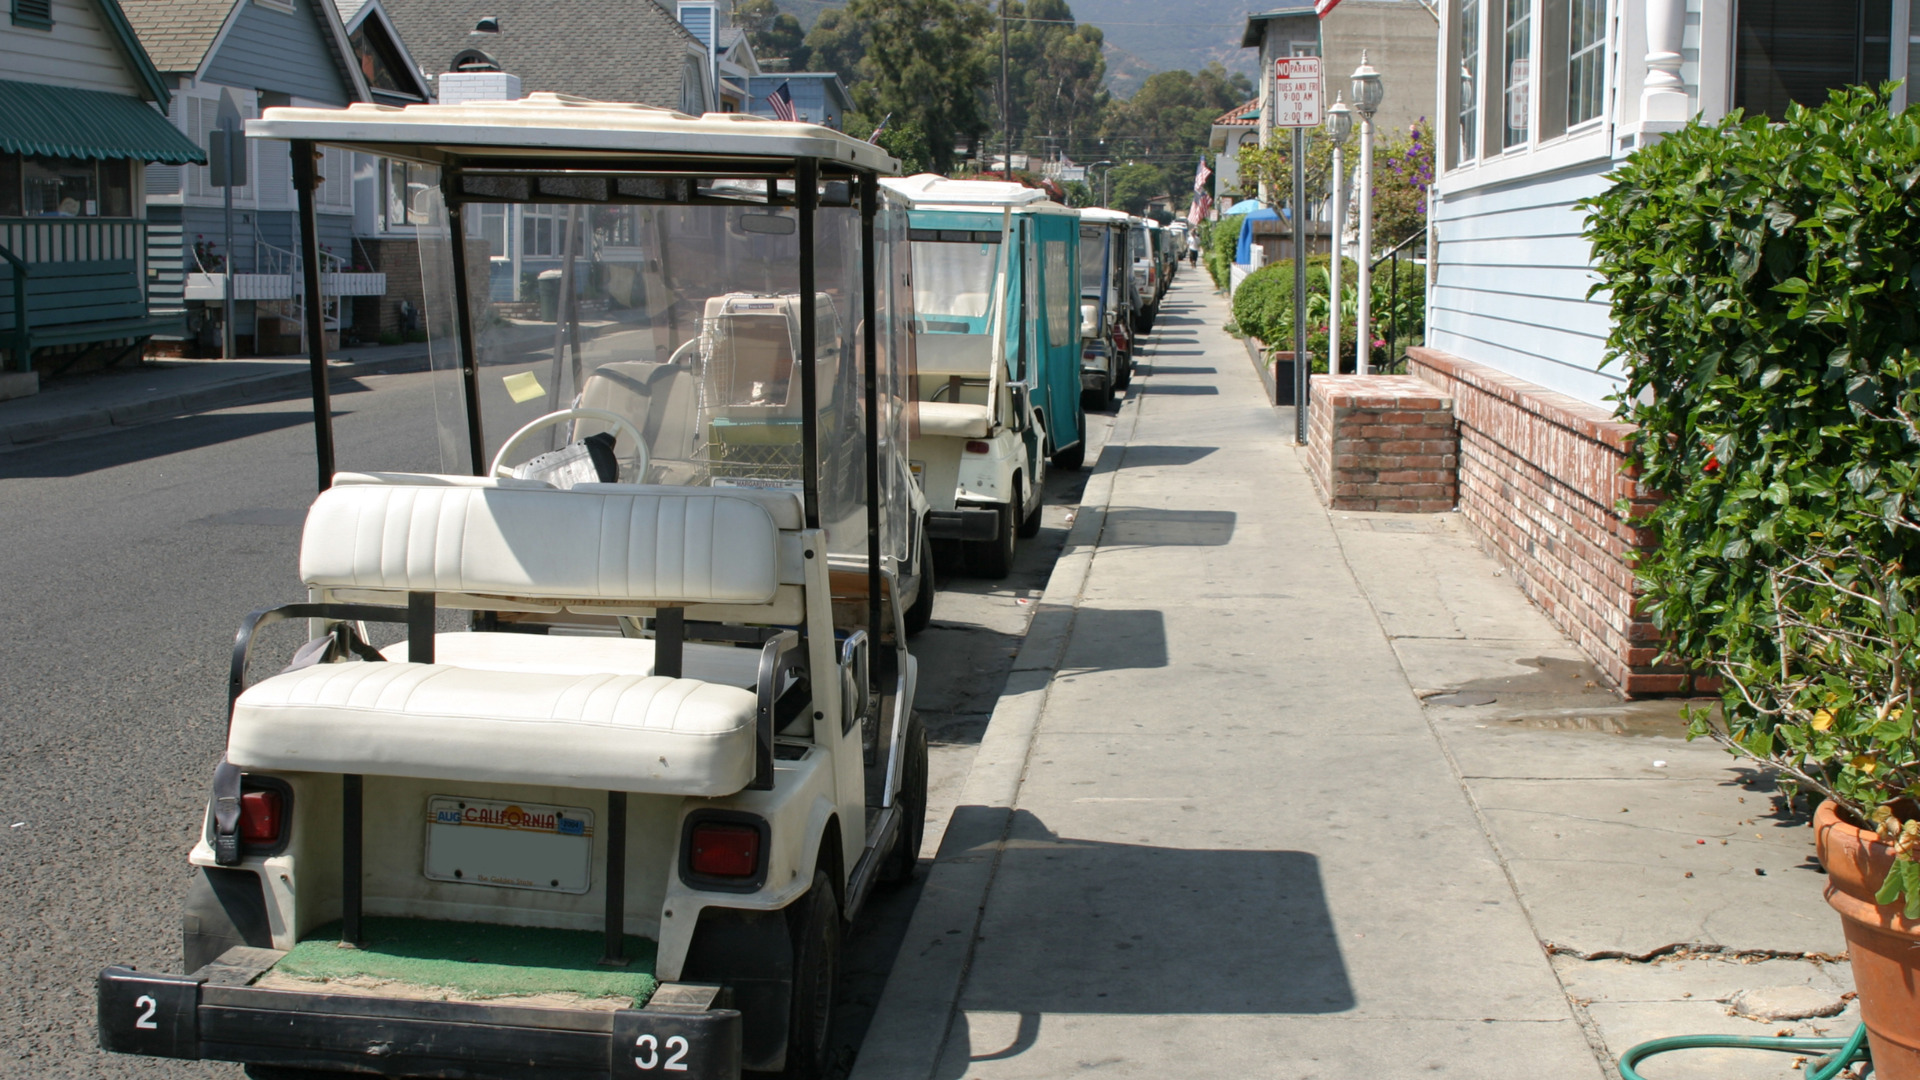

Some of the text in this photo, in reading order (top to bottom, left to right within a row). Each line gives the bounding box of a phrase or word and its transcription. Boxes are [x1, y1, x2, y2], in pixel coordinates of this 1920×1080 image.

[1277, 63, 1318, 76] NO PARKING
[1278, 82, 1319, 91] TUES AND FRI
[1283, 92, 1300, 101] 9:00
[1294, 102, 1302, 111] TO
[1283, 112, 1313, 121] 2:00 PM
[438, 811, 461, 822] AUG
[465, 808, 555, 829] CALIFORNIA
[136, 994, 157, 1029] 2
[635, 1034, 689, 1071] 32
